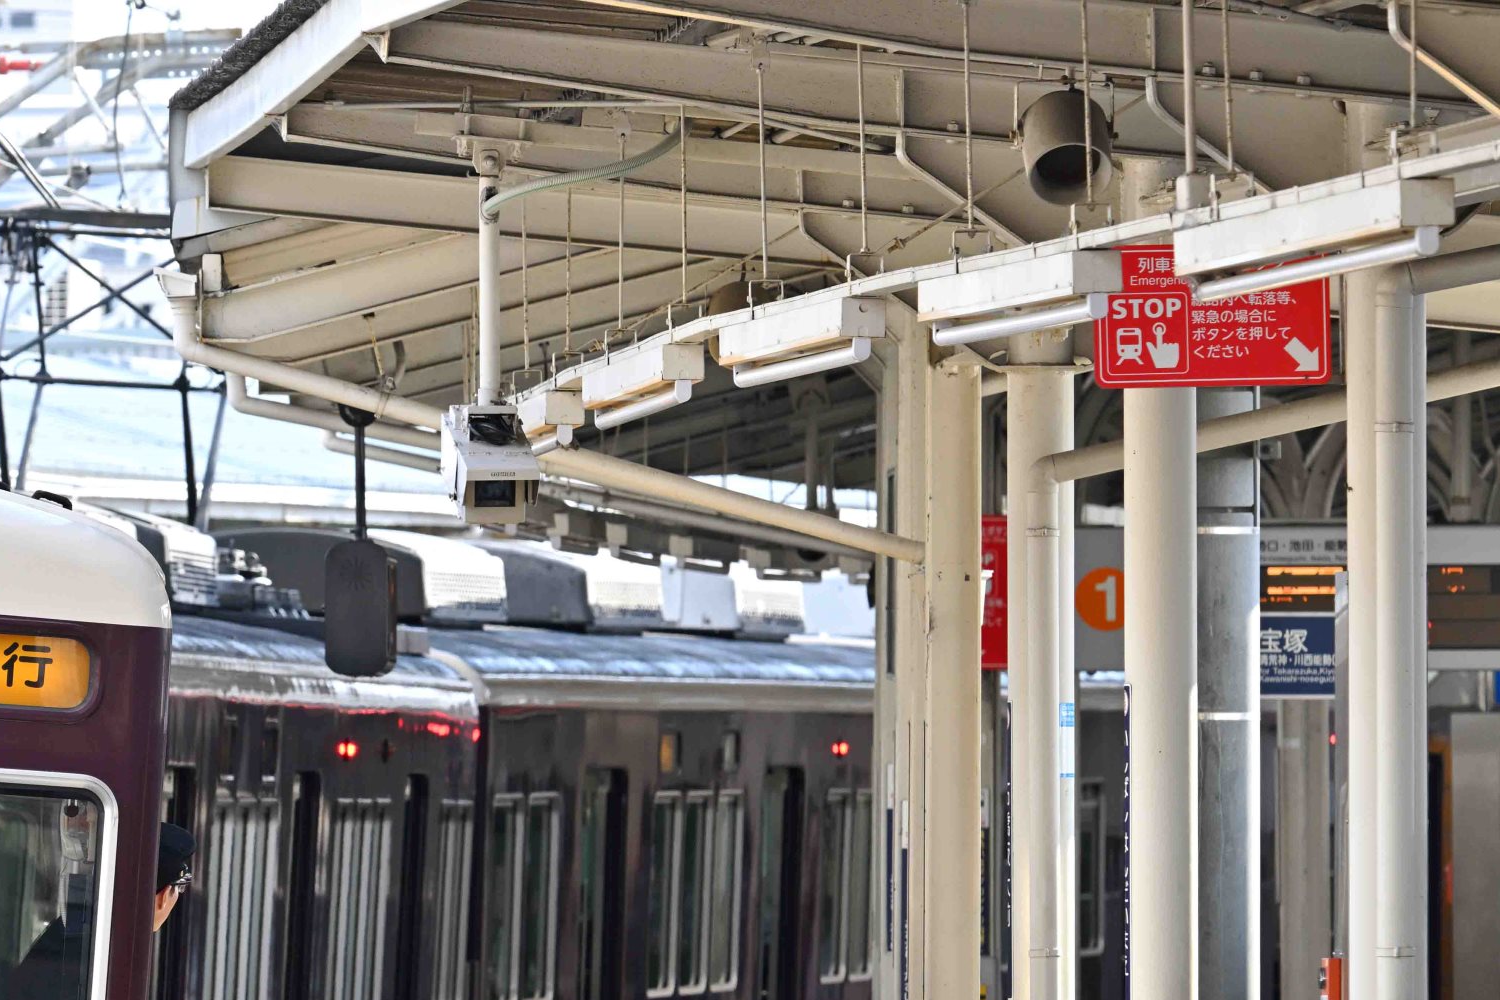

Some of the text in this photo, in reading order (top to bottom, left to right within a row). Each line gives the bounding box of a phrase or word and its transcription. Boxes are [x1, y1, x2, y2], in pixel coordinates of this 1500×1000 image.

[1138, 257, 1175, 274] 列車
[1112, 299, 1182, 319] STOP
[1192, 309, 1277, 324] 緊急の場合に
[1192, 327, 1291, 340] ボタンを押して
[1194, 346, 1250, 359] ください
[1095, 575, 1117, 622] 1
[1260, 628, 1308, 653] 宝塚
